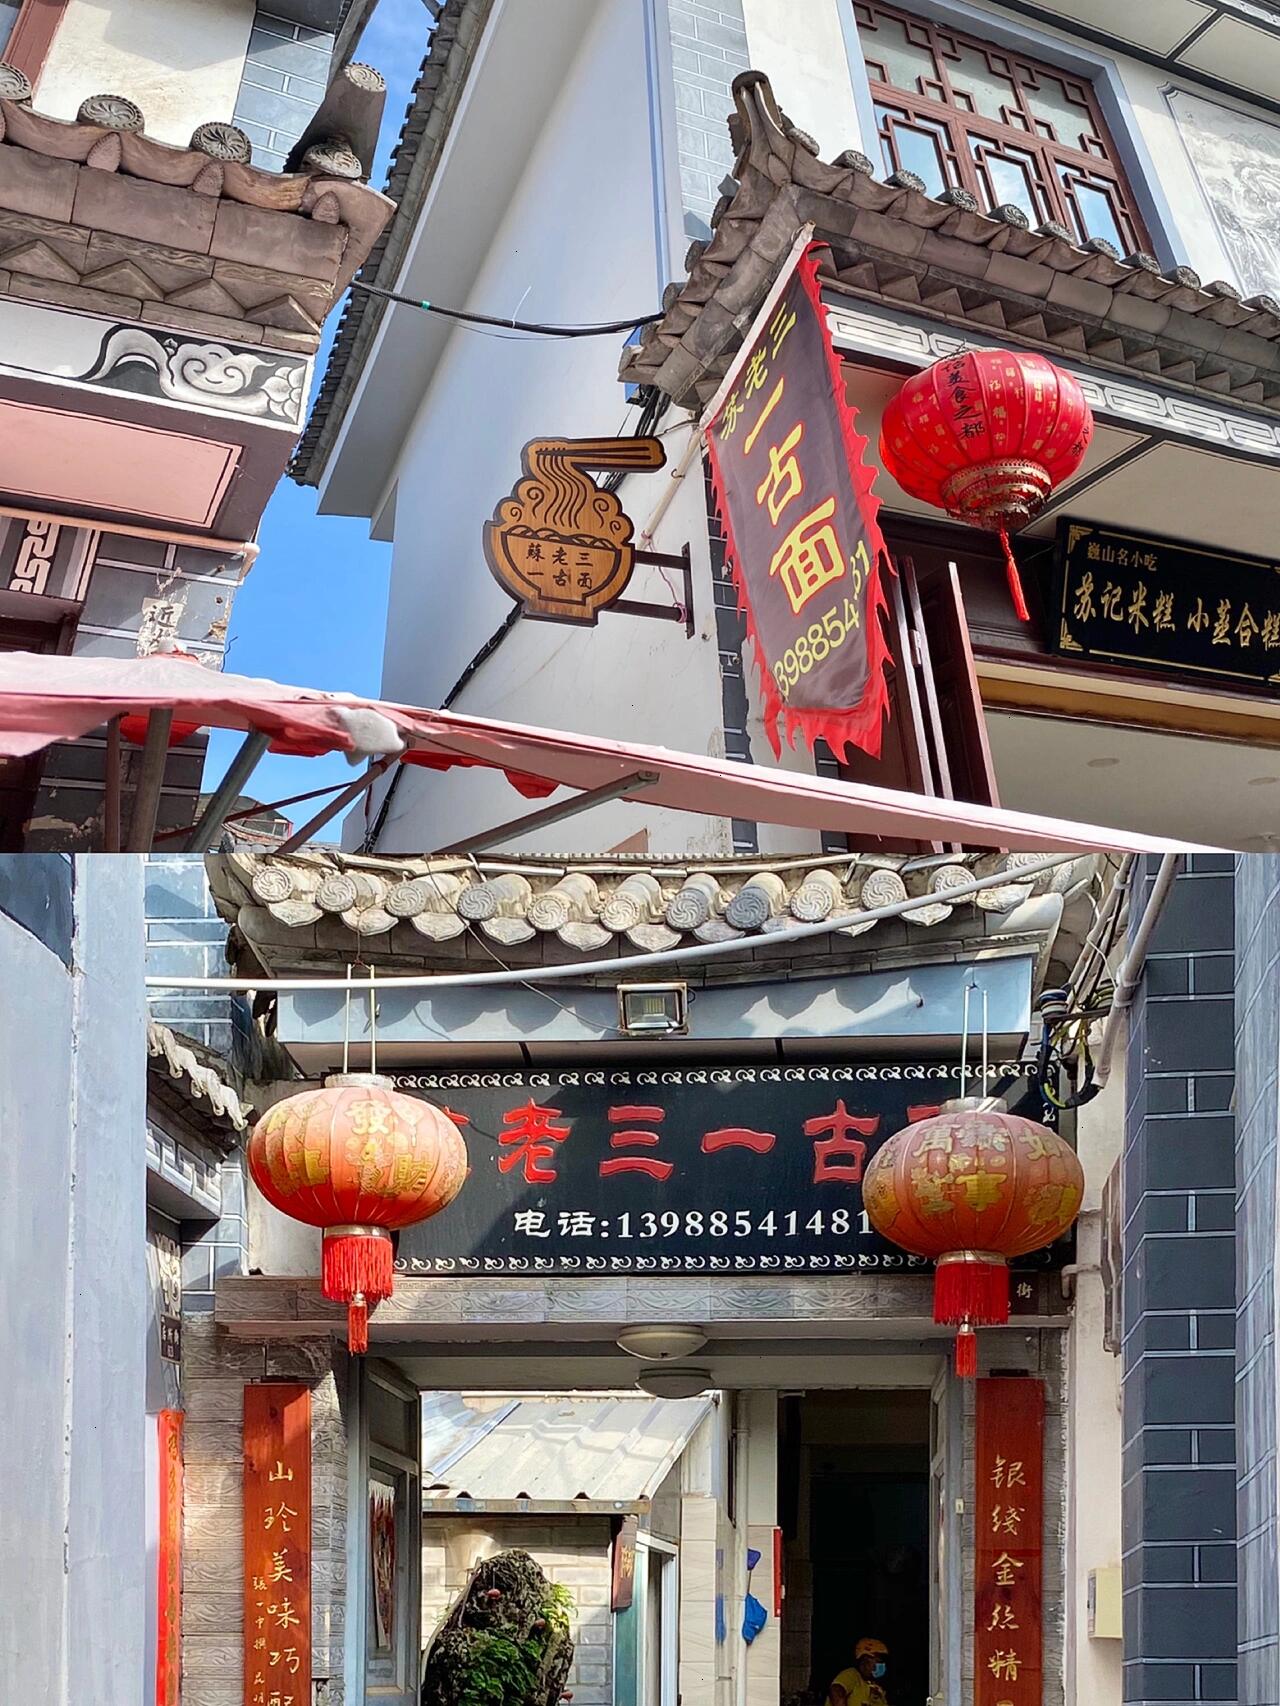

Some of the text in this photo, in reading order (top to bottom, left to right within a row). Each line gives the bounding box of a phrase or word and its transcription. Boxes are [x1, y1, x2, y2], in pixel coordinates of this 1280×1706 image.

[744, 376, 846, 614] 一古面
[445, 1097, 940, 1184] 老三一古
